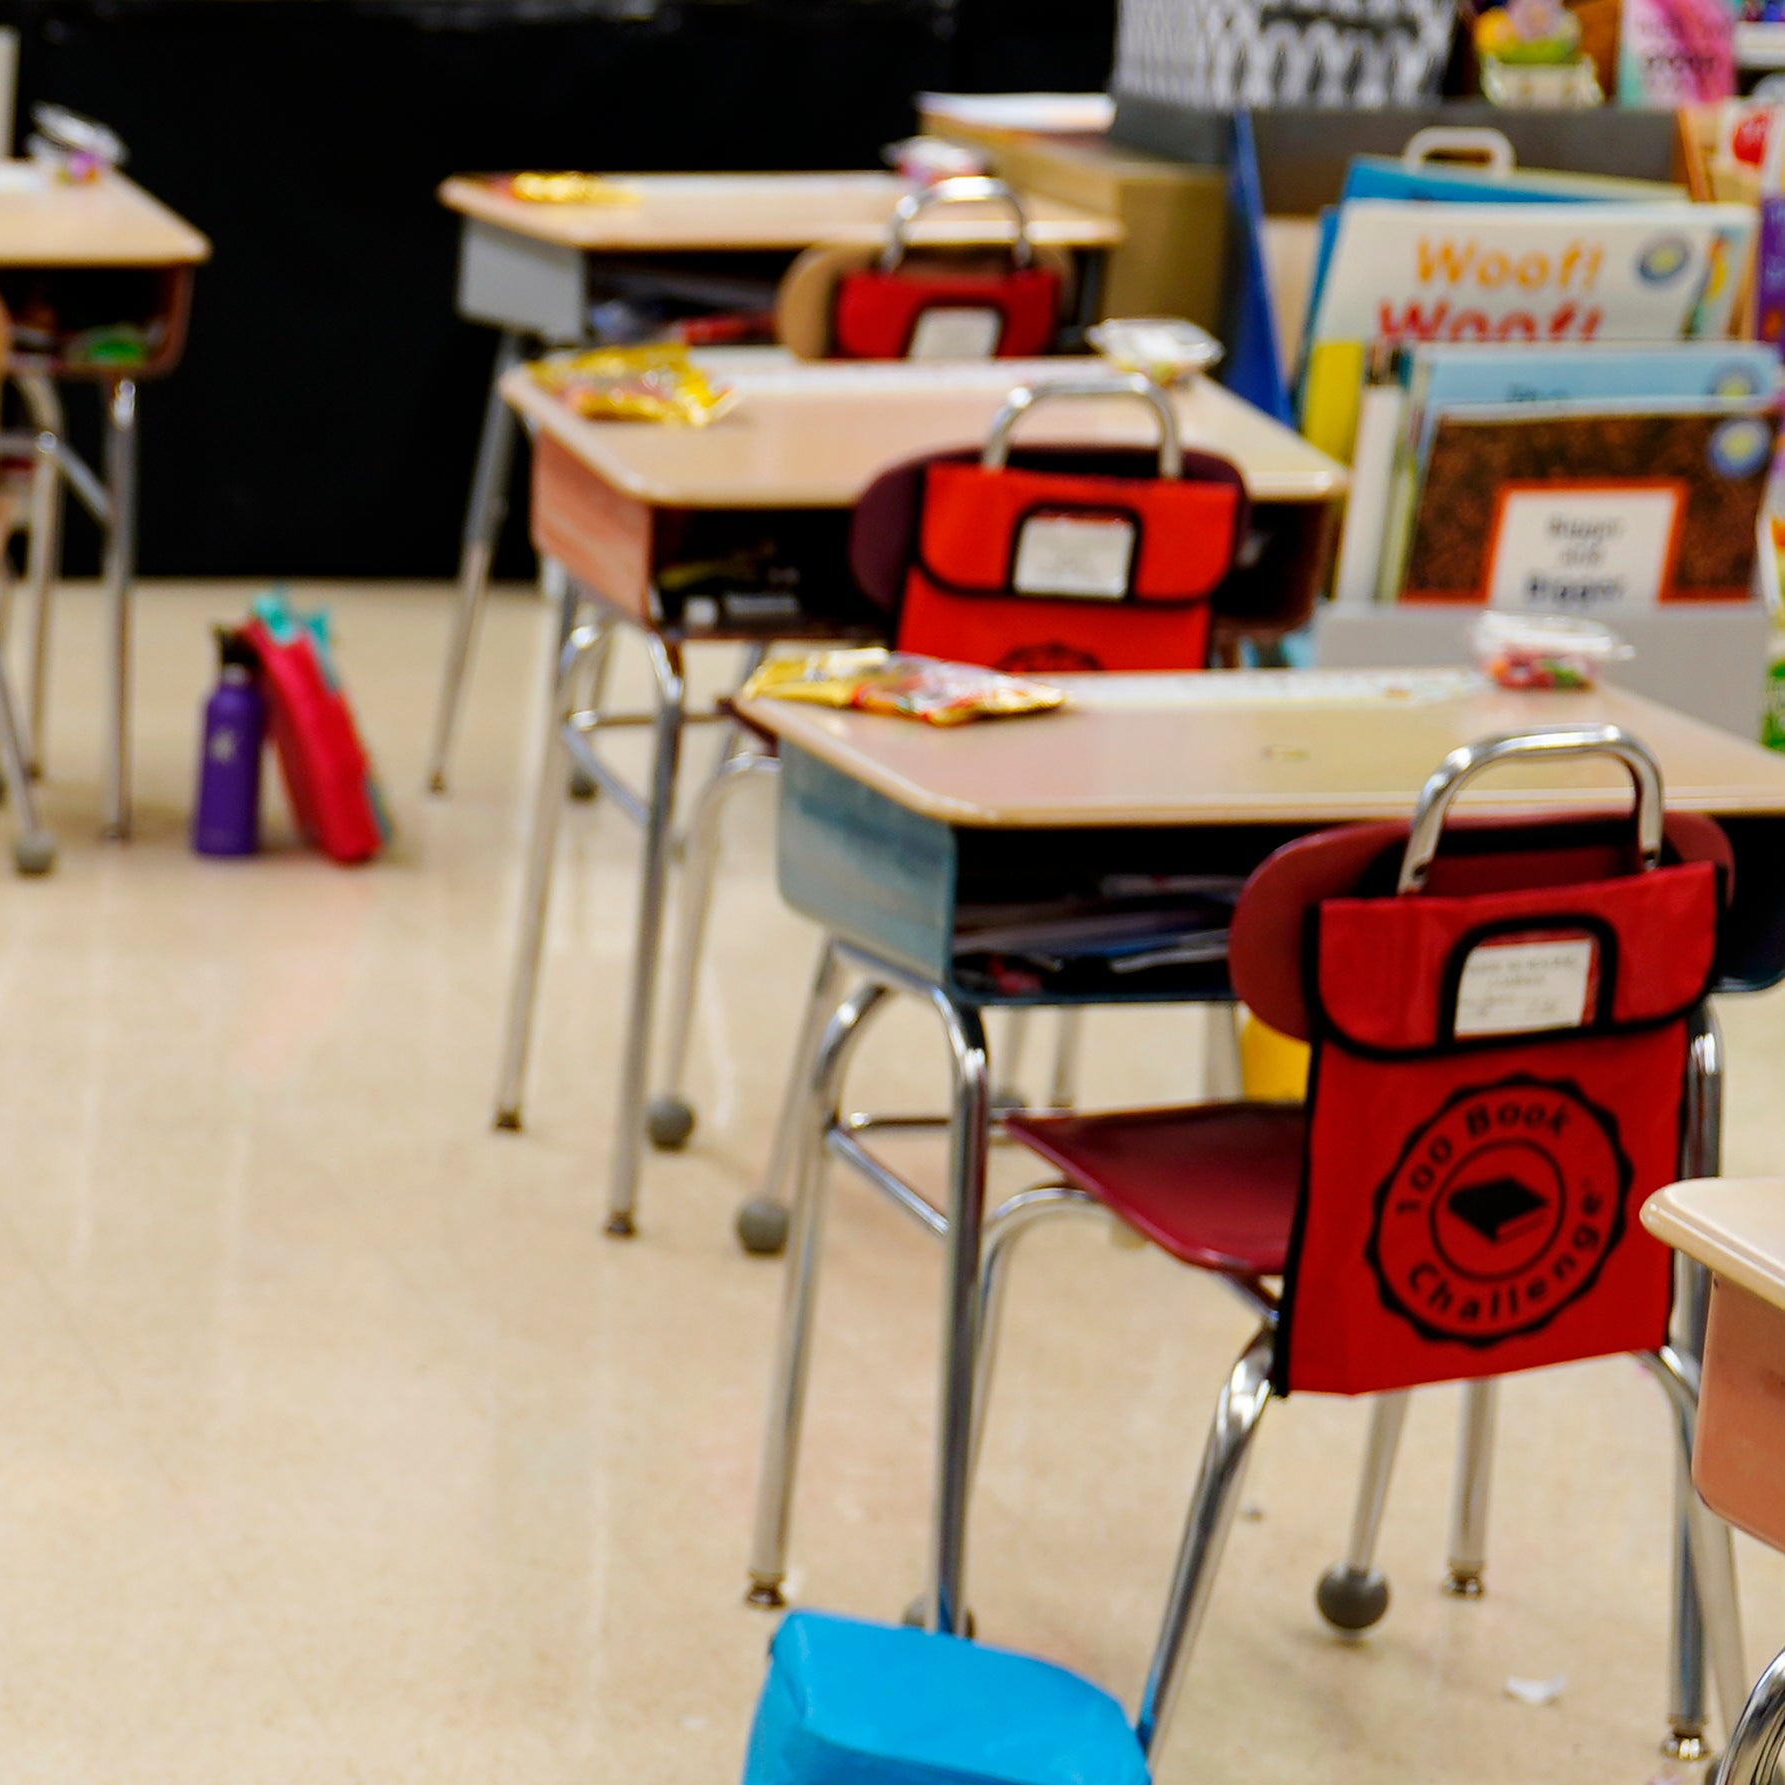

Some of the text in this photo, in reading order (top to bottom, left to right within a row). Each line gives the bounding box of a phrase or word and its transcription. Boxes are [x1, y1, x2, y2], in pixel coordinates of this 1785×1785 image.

[1416, 236, 1605, 291] Woof!
[1396, 1101, 1569, 1217] 100 Book
